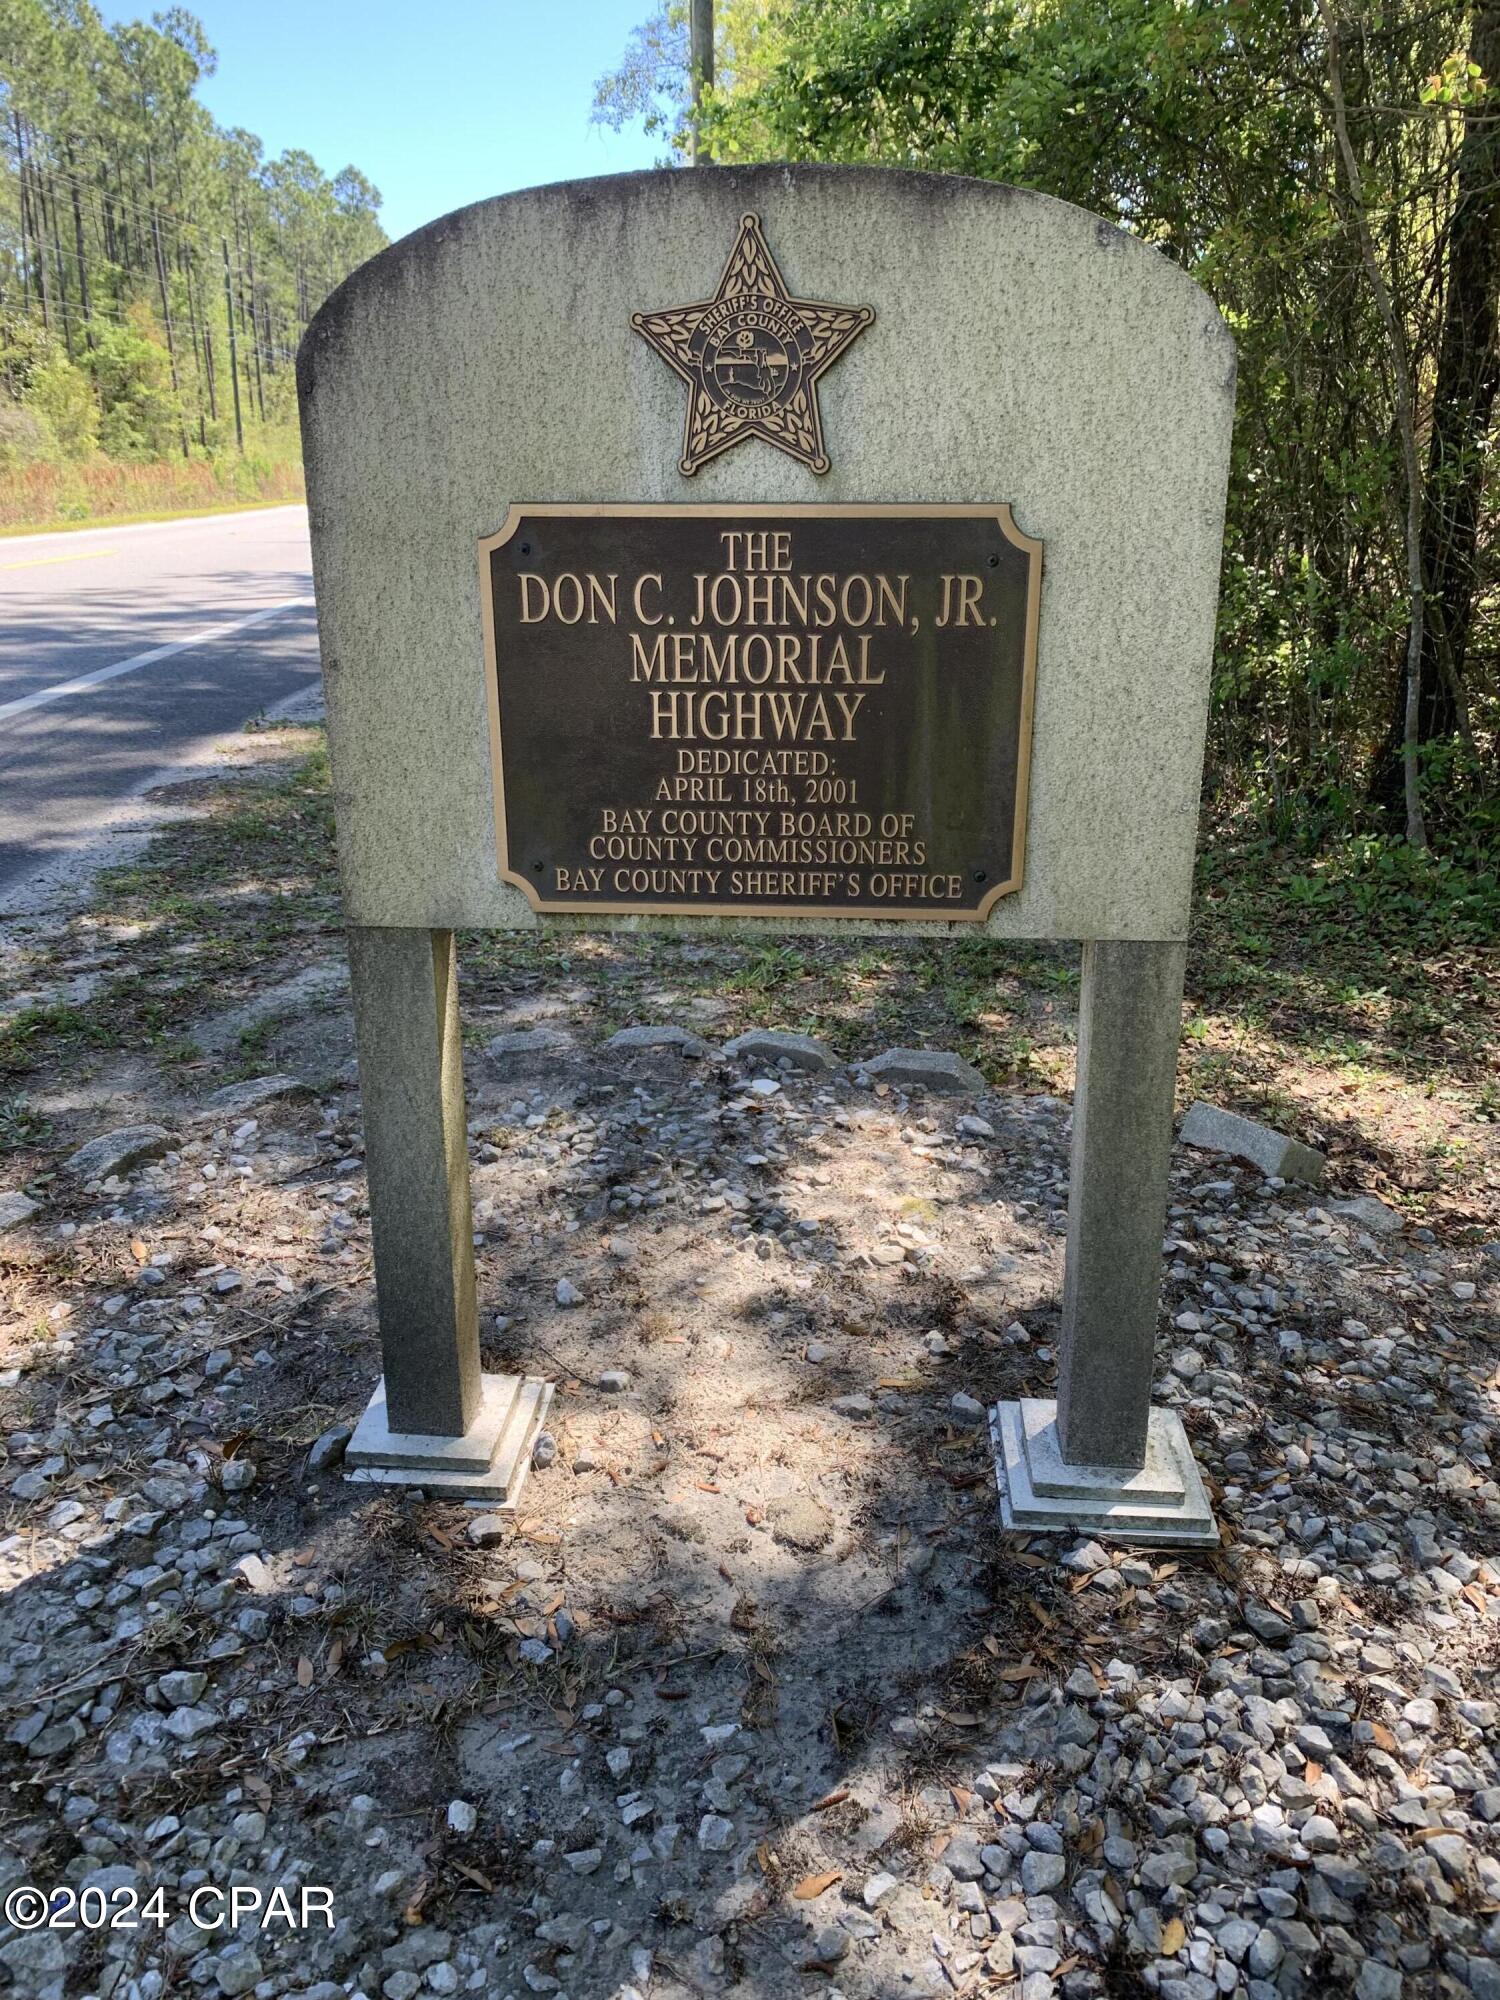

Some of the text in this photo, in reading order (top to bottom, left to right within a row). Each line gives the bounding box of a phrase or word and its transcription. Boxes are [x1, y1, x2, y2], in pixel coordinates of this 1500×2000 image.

[699, 296, 804, 334] SHERIFF'S OFFICE
[709, 315, 793, 347] BAY COUNTY
[722, 401, 783, 419] FLORIDA
[720, 532, 793, 572] THE
[517, 573, 997, 637] DON C. JOHNSON, JR.
[629, 632, 886, 685] MEMORIAL
[649, 690, 867, 741] HIGHWAY
[677, 750, 836, 776] DEDICATED:
[655, 778, 858, 807] APRIL 18th, 2001
[602, 810, 916, 839] BAY COUNTY BOARD OF
[589, 836, 927, 866] COUNTY COMMISSIONERS
[555, 868, 963, 900] BAY COUNTY SHERIFF'S OFFICE
